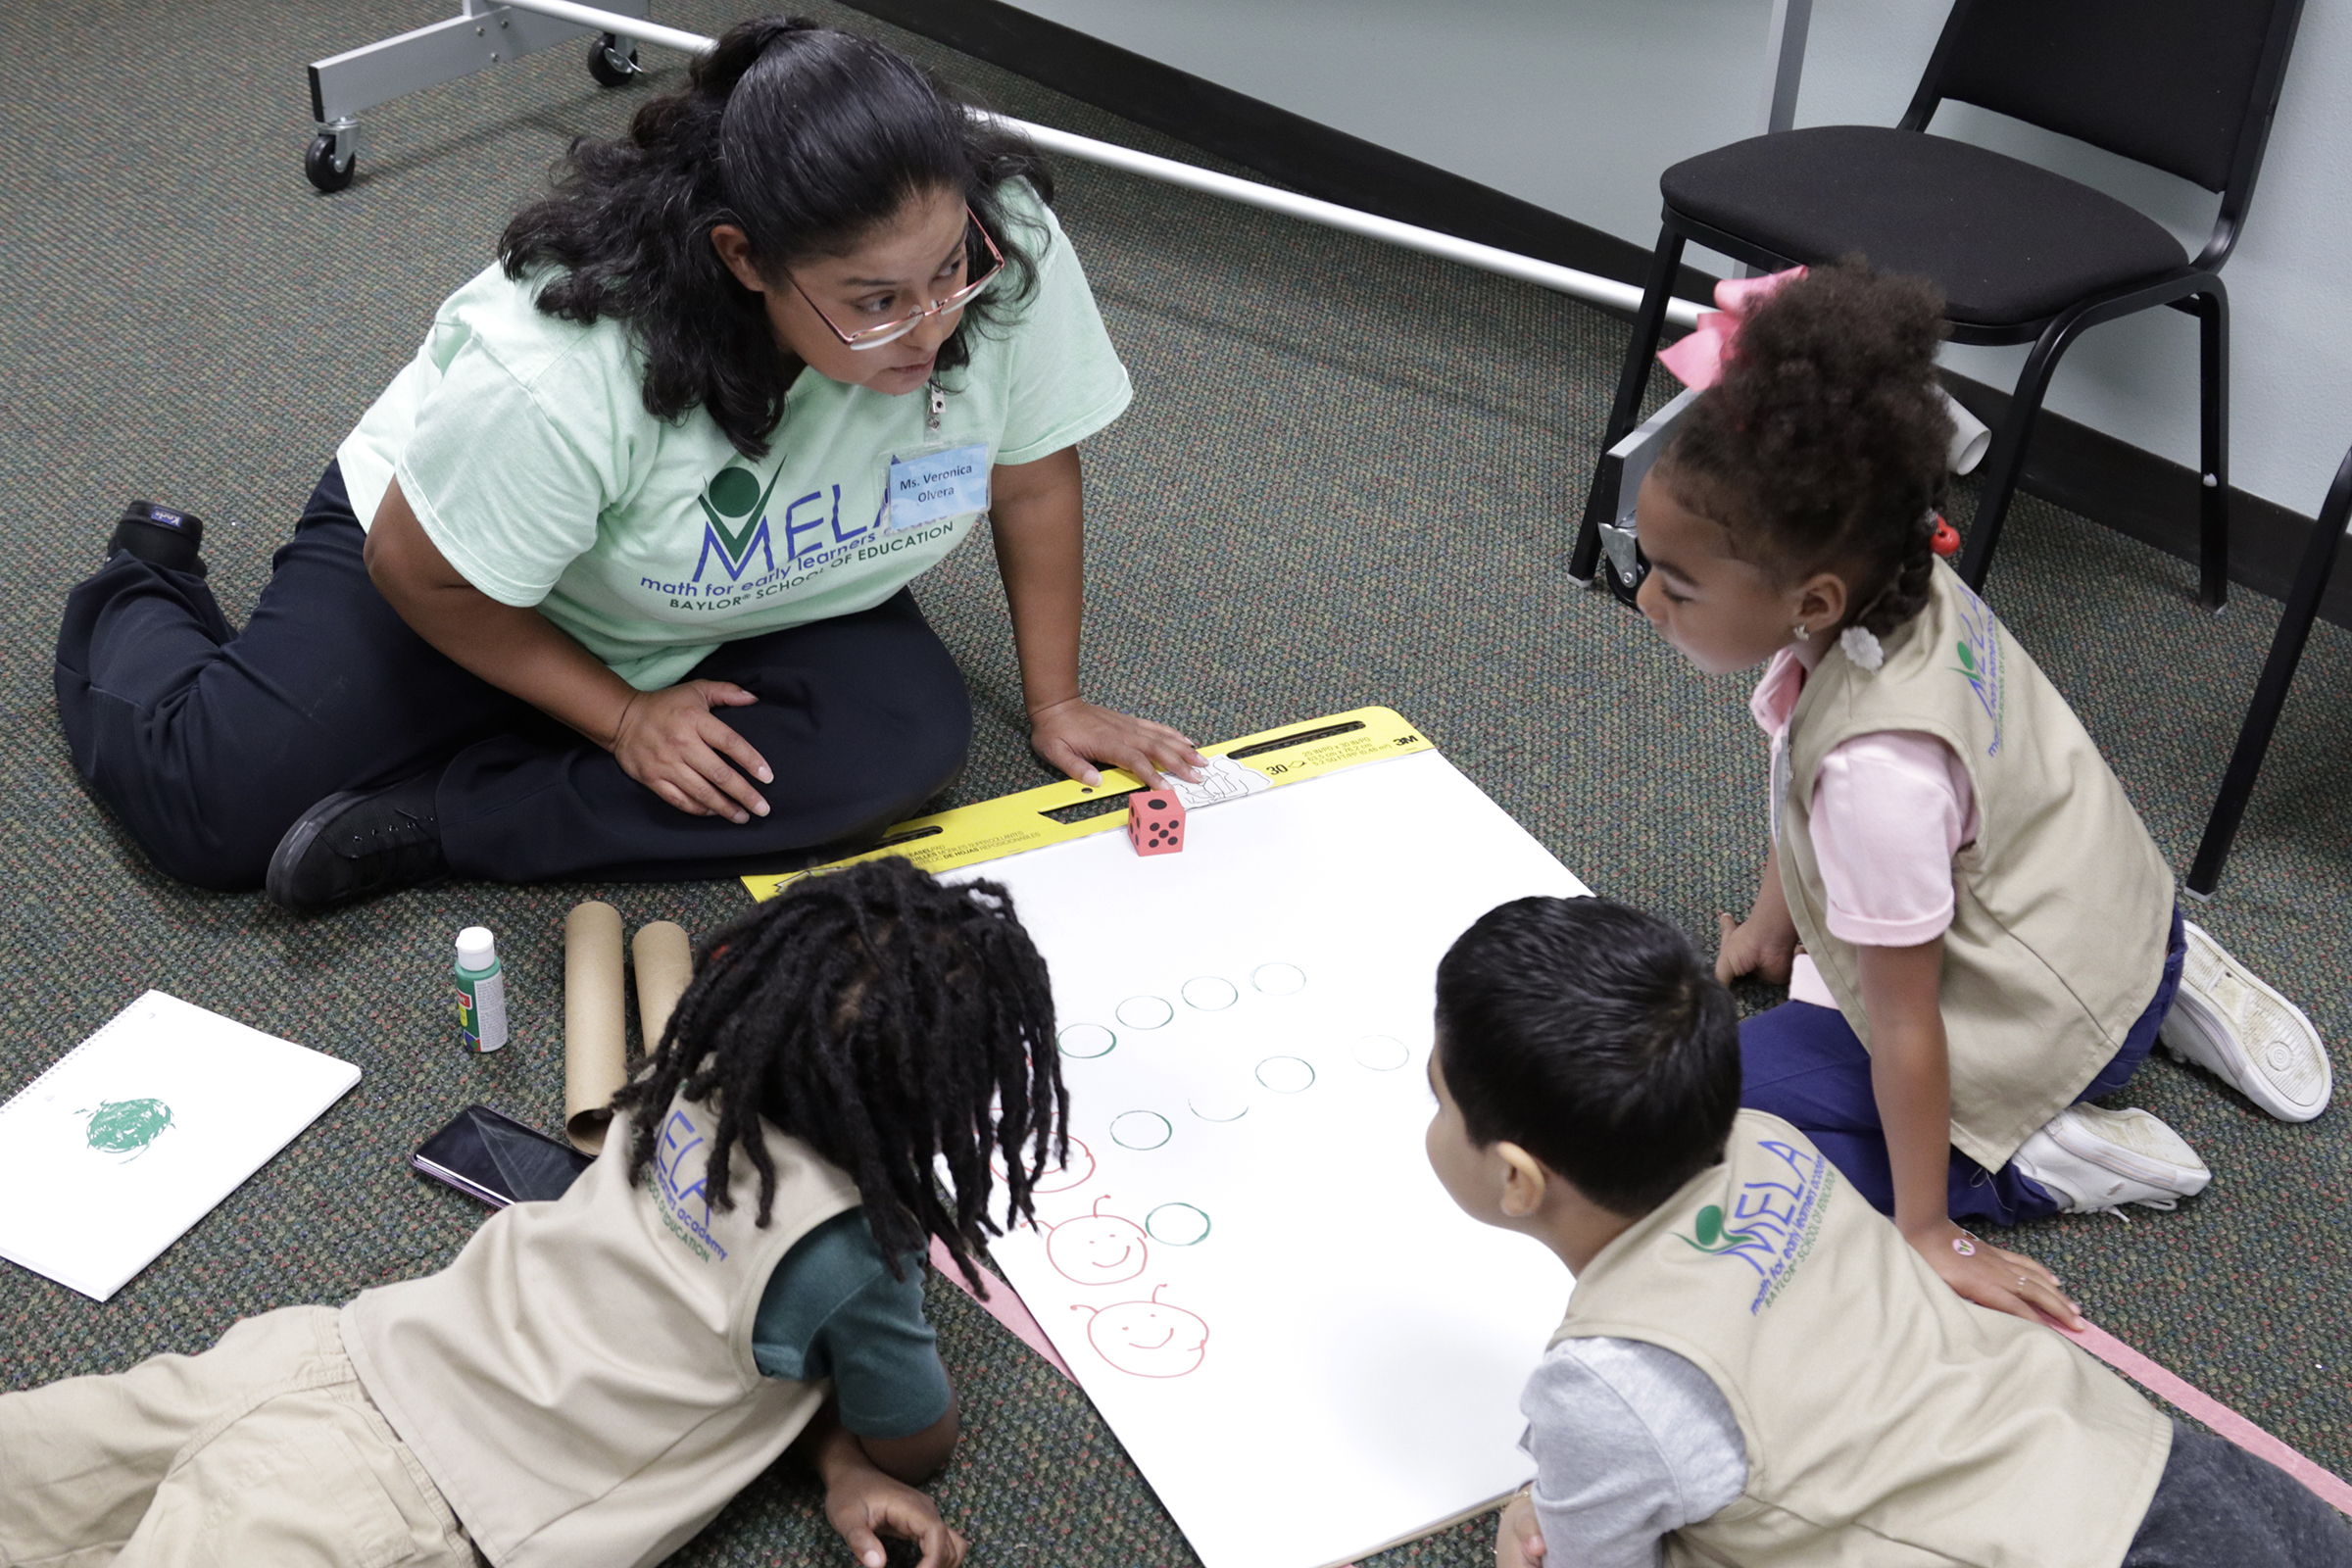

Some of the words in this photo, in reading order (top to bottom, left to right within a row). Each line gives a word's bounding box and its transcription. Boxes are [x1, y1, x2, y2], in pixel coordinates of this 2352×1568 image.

[900, 479, 920, 491] Ms.
[923, 466, 972, 484] Veronica
[918, 487, 955, 503] Olvera
[155, 511, 181, 525] Keds
[641, 576, 698, 597] math
[706, 584, 733, 597] for
[741, 565, 791, 592] early
[798, 531, 875, 571] learners
[756, 571, 825, 600] SCHOOL
[830, 555, 853, 568] OF
[858, 521, 954, 562] EDUCATION
[1393, 735, 1419, 747] 3M
[1266, 763, 1289, 775] 30
[955, 848, 979, 858] HOJAS
[979, 832, 1041, 851] REPOSICIONABLES
[677, 1207, 728, 1262] academy
[1713, 1141, 1813, 1277] MELA
[1797, 1224, 1822, 1263] SCHOOL
[1816, 1209, 1824, 1226] OF
[1821, 1170, 1837, 1213] EDUCATION
[662, 1212, 710, 1263] EDUCATION
[1750, 1278, 1773, 1316] math
[1770, 1258, 1786, 1280] for
[1783, 1227, 1804, 1260] early
[1794, 1189, 1819, 1231] learners
